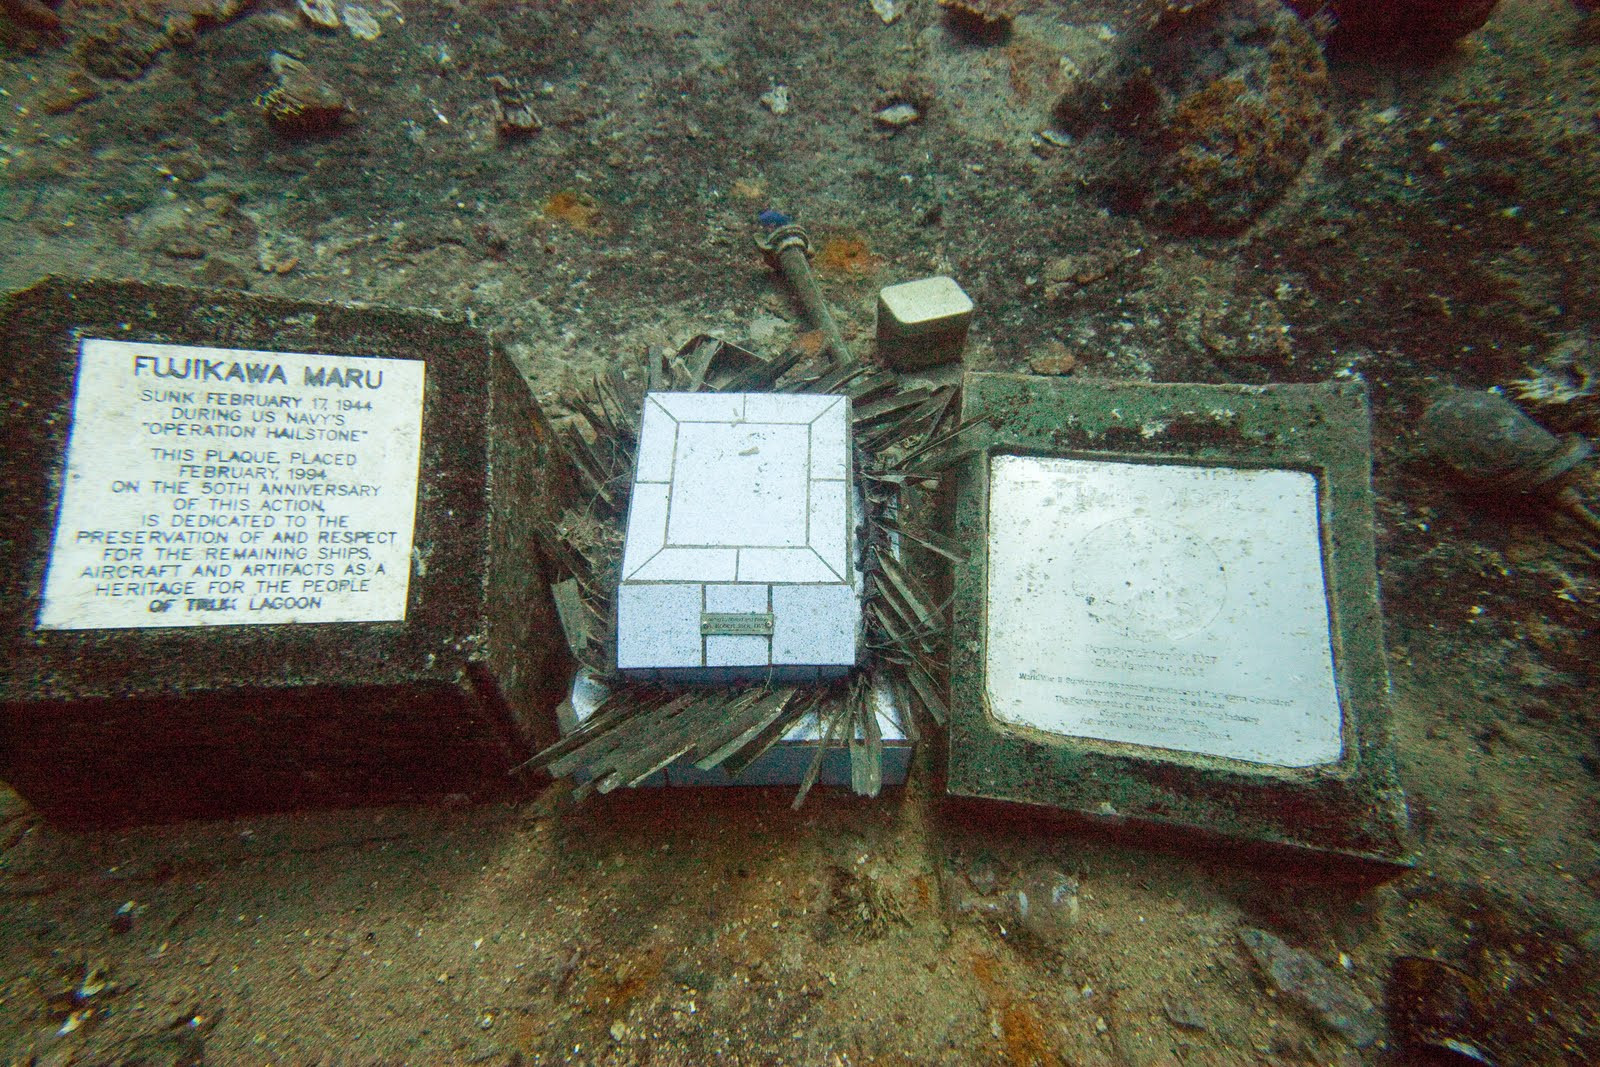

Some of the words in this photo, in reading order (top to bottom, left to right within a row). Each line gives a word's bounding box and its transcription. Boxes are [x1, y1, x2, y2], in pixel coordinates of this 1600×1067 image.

[134, 355, 287, 385] FUJIKAWA
[304, 366, 382, 389] MARU
[140, 390, 193, 403] SUNK
[207, 393, 302, 407] FEBRUARY
[337, 399, 373, 411] 1944
[171, 407, 241, 422] DURING
[253, 411, 275, 422] US
[287, 413, 345, 425] NAVY'S
[142, 422, 255, 438] "OPERATION
[266, 427, 368, 441] HAILSTONE"
[150, 448, 194, 461] THIS
[290, 452, 357, 466] PLACED
[179, 465, 279, 480] FEBRUARY,
[288, 468, 327, 479] 1994
[111, 481, 139, 493] ON
[152, 482, 188, 494] THE
[201, 482, 249, 495] 50TH
[260, 484, 381, 497] ANNIVERSARY
[173, 498, 199, 511] OF
[209, 498, 249, 511] THIS
[141, 514, 159, 527] IS
[171, 515, 275, 527] DEDICATED
[285, 515, 306, 527] TO
[316, 515, 349, 528] THE
[76, 531, 228, 545] PRESERVATION
[240, 531, 264, 544] OF
[272, 531, 308, 544] AND
[318, 531, 397, 544] RESPECT
[103, 548, 143, 561] FOR
[155, 547, 193, 560] THE
[206, 547, 307, 560] REMAINING
[317, 547, 372, 560] SHIPS,
[80, 564, 182, 578] AIRCRAFT
[192, 564, 232, 577] AND
[242, 564, 334, 577] ARTIFACTS
[344, 563, 366, 576] AS
[375, 563, 386, 576] A
[96, 582, 195, 596] HERITAGE
[208, 581, 245, 594] FOR
[256, 580, 289, 593] THE
[303, 580, 370, 592] PEOPLE
[148, 599, 177, 612] OF
[249, 597, 322, 610] LAGOON
